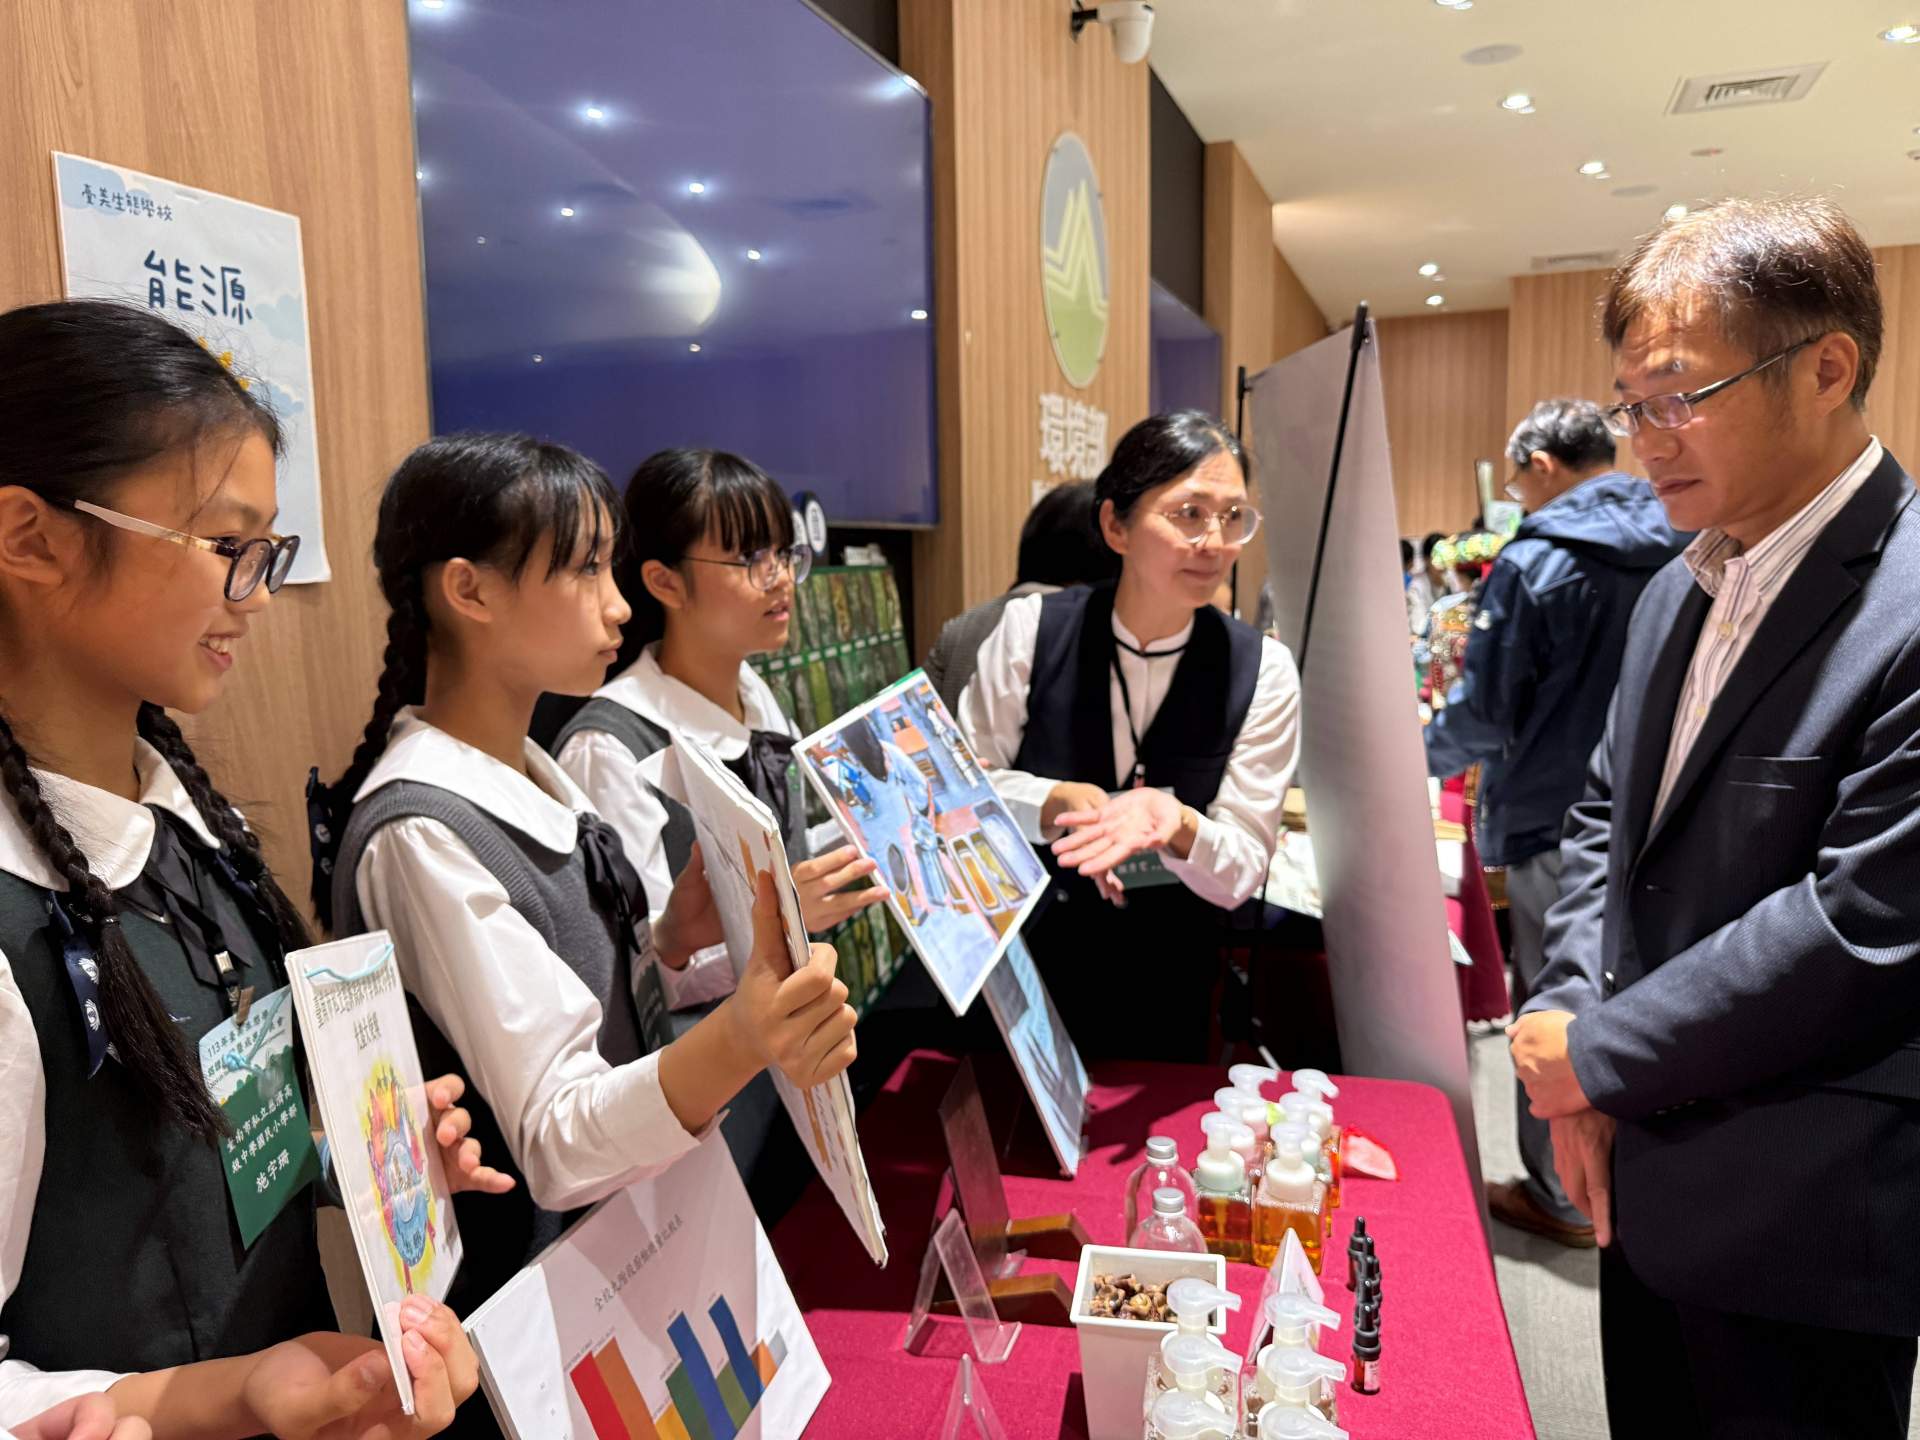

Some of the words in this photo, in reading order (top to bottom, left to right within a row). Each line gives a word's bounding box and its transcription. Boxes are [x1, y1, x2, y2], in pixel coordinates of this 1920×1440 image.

[81, 183, 174, 222] 臺美生態學校
[143, 249, 253, 326] 能源
